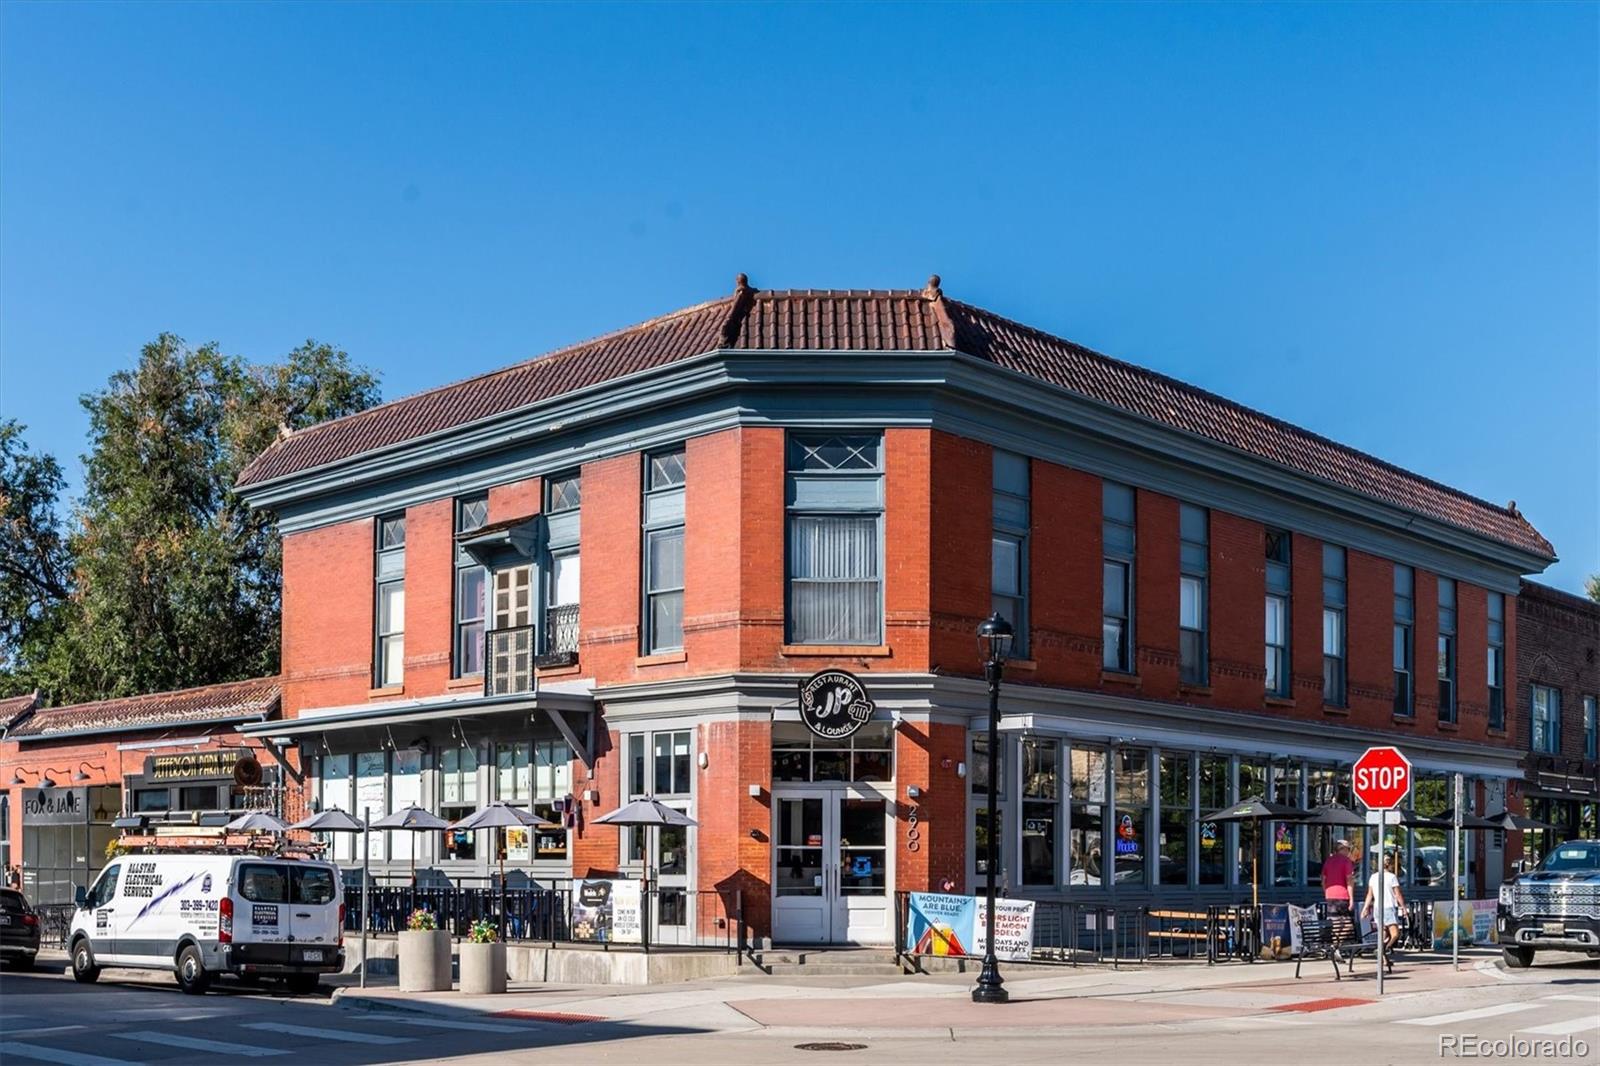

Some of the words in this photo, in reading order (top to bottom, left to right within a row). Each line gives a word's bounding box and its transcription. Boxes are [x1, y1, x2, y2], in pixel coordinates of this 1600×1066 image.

[810, 675, 858, 693] RESTAURANT
[815, 687, 852, 718] JP
[821, 722, 853, 735] LOUNGE
[154, 756, 197, 778] JEFFERSON
[198, 754, 219, 776] PARK
[1357, 766, 1405, 790] STOP
[25, 800, 44, 815] FOX
[46, 799, 54, 814] &
[56, 797, 81, 814] JANE
[907, 805, 919, 852] 2900
[128, 863, 157, 873] ALLSTAR
[125, 874, 163, 886] ELECTRICAL
[123, 886, 153, 897] SERVICES
[919, 895, 968, 905] MOUNTAINS
[979, 913, 1007, 921] CRS
[1008, 915, 1031, 923] LIGHT
[1001, 922, 1028, 930] MOON
[993, 929, 1021, 937] ODELO
[977, 938, 1013, 946] MDAYS
[1014, 940, 1030, 948] AND
[979, 944, 1026, 953] WNESDAYS
